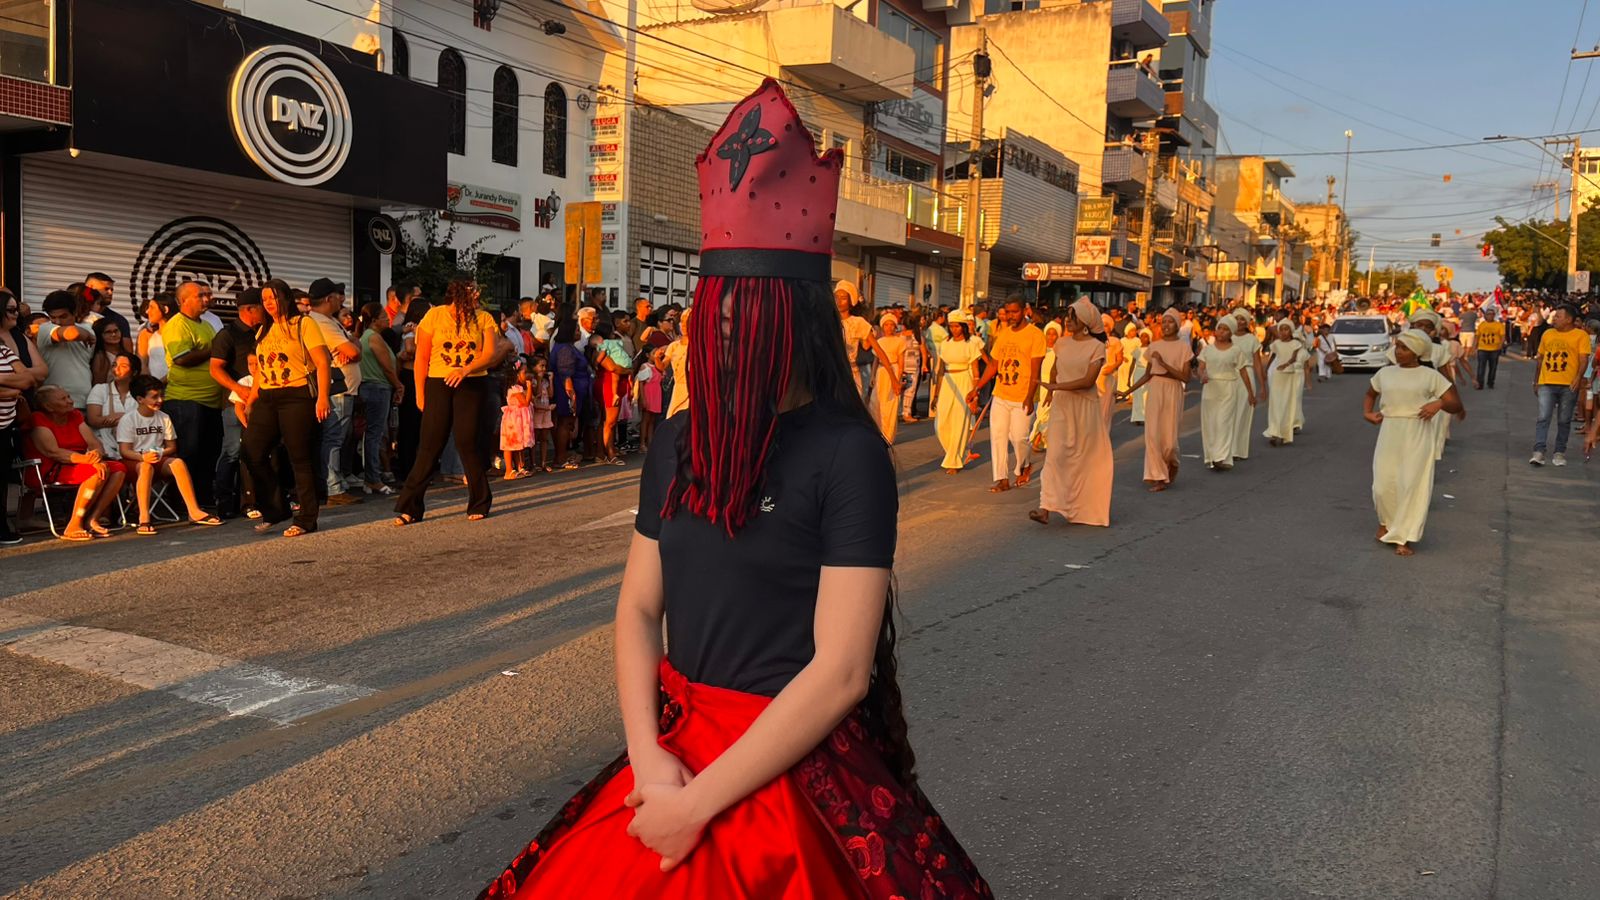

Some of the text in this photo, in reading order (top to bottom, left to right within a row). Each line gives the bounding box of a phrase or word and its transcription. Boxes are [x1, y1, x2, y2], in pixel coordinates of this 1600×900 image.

[272, 95, 324, 131] DNZ
[498, 194, 518, 206] Pereira
[373, 228, 391, 241] DNZ
[136, 425, 163, 435] BELEVE
